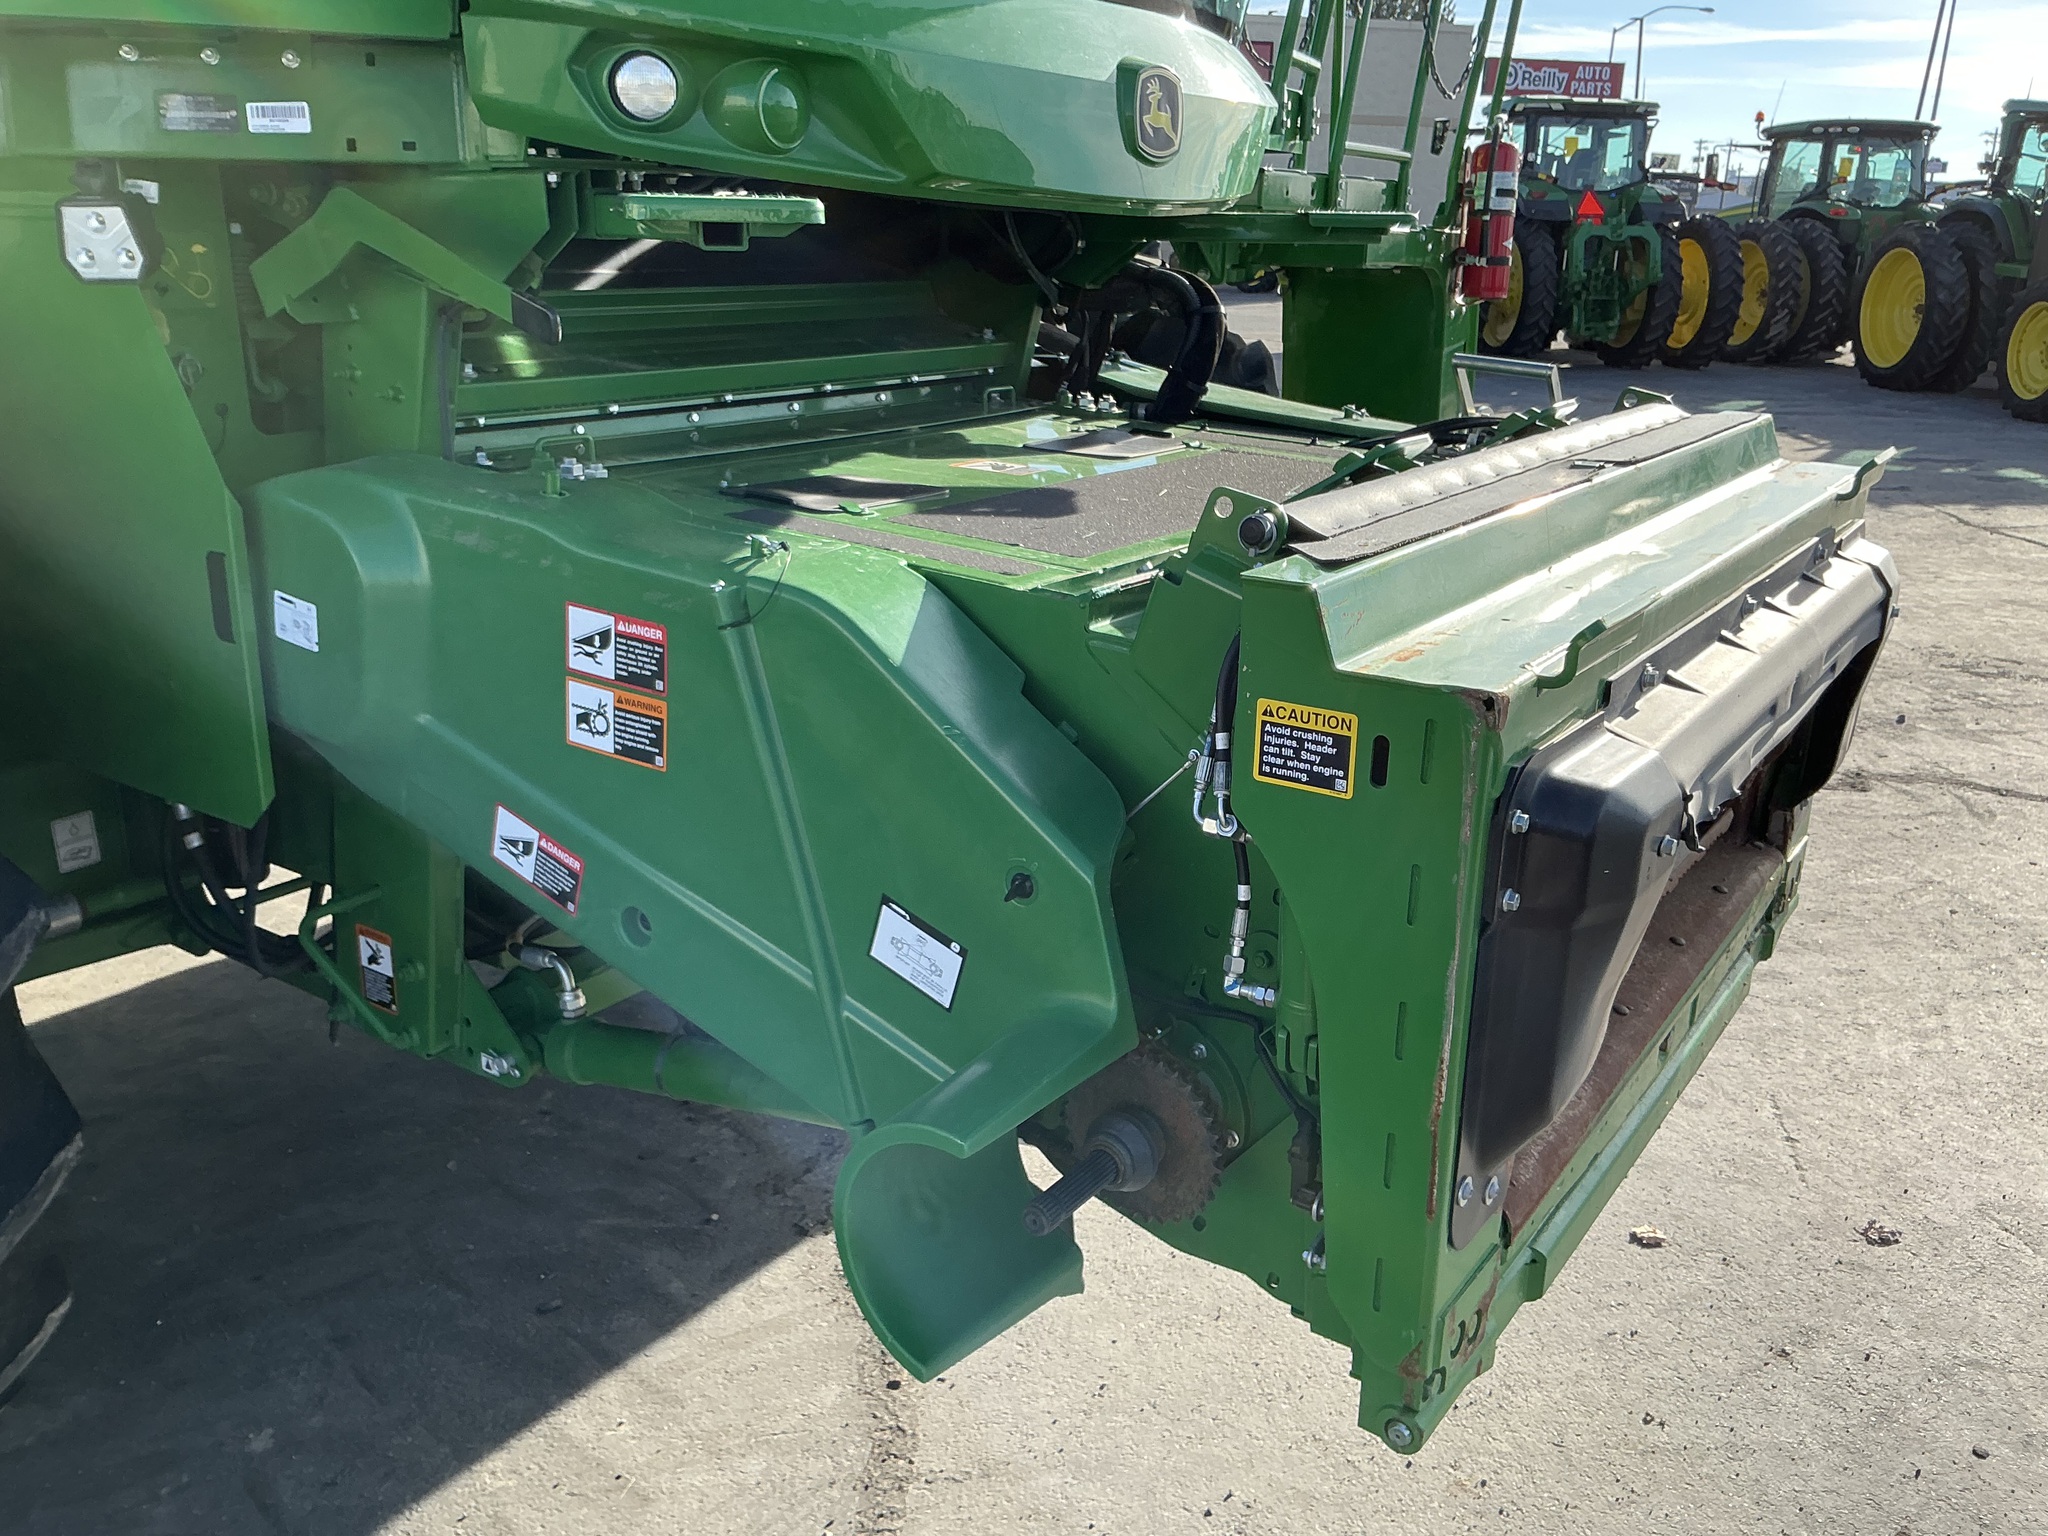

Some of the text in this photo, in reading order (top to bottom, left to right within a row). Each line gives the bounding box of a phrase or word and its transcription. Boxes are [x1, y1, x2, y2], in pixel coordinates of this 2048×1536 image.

[1575, 65, 1611, 80] AUTO
[1570, 81, 1612, 96] PARTS
[623, 697, 663, 715] WARNING
[1276, 706, 1352, 732] CAUTION
[1264, 723, 1333, 745] Avoid crushing
[1264, 733, 1337, 755] injuries. Header
[1263, 745, 1321, 763] can tilt. Stay
[1262, 763, 1310, 782] is running.
[1263, 755, 1344, 778] clear when engine
[547, 844, 580, 871] DANGER
